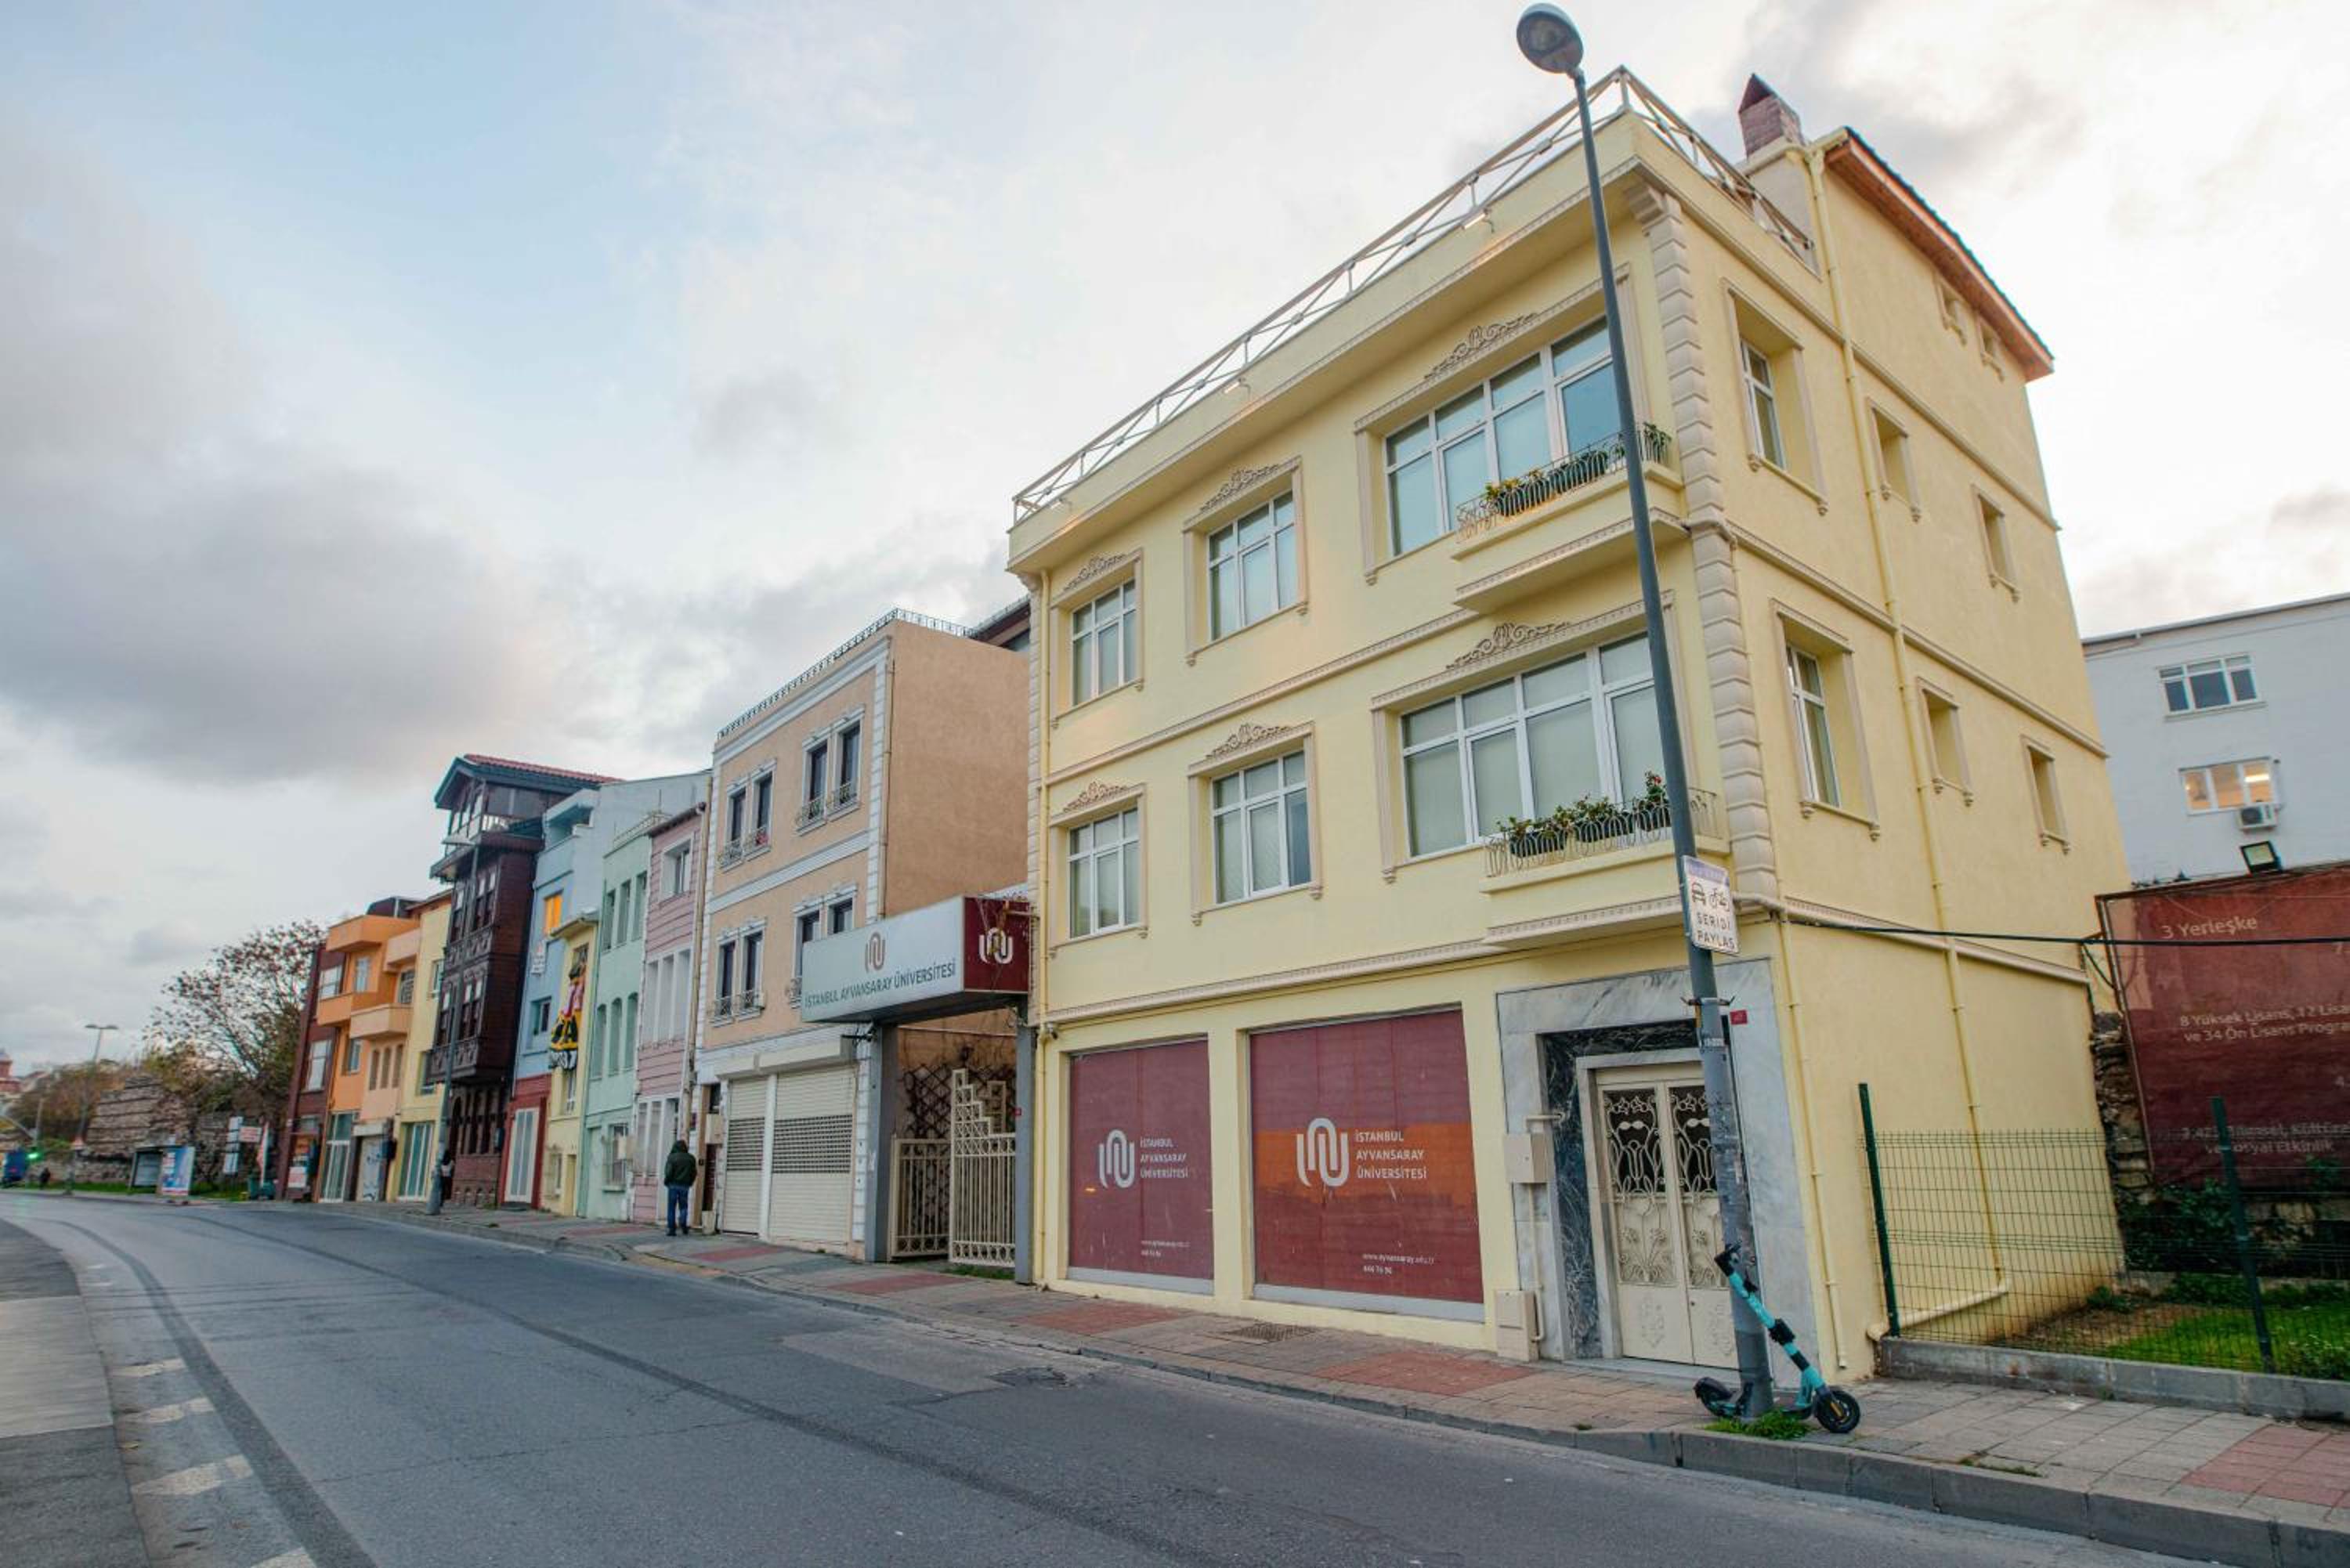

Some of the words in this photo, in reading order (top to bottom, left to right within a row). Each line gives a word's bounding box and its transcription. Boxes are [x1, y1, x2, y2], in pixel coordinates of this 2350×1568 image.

[2162, 925, 2174, 939] 3
[2177, 916, 2257, 937] Yerleşke
[1355, 1129, 1405, 1143] İSTANBUL
[1356, 1148, 1424, 1161] AYVANSARAY
[1357, 1165, 1427, 1179] ÜNİVERSİTESİ
